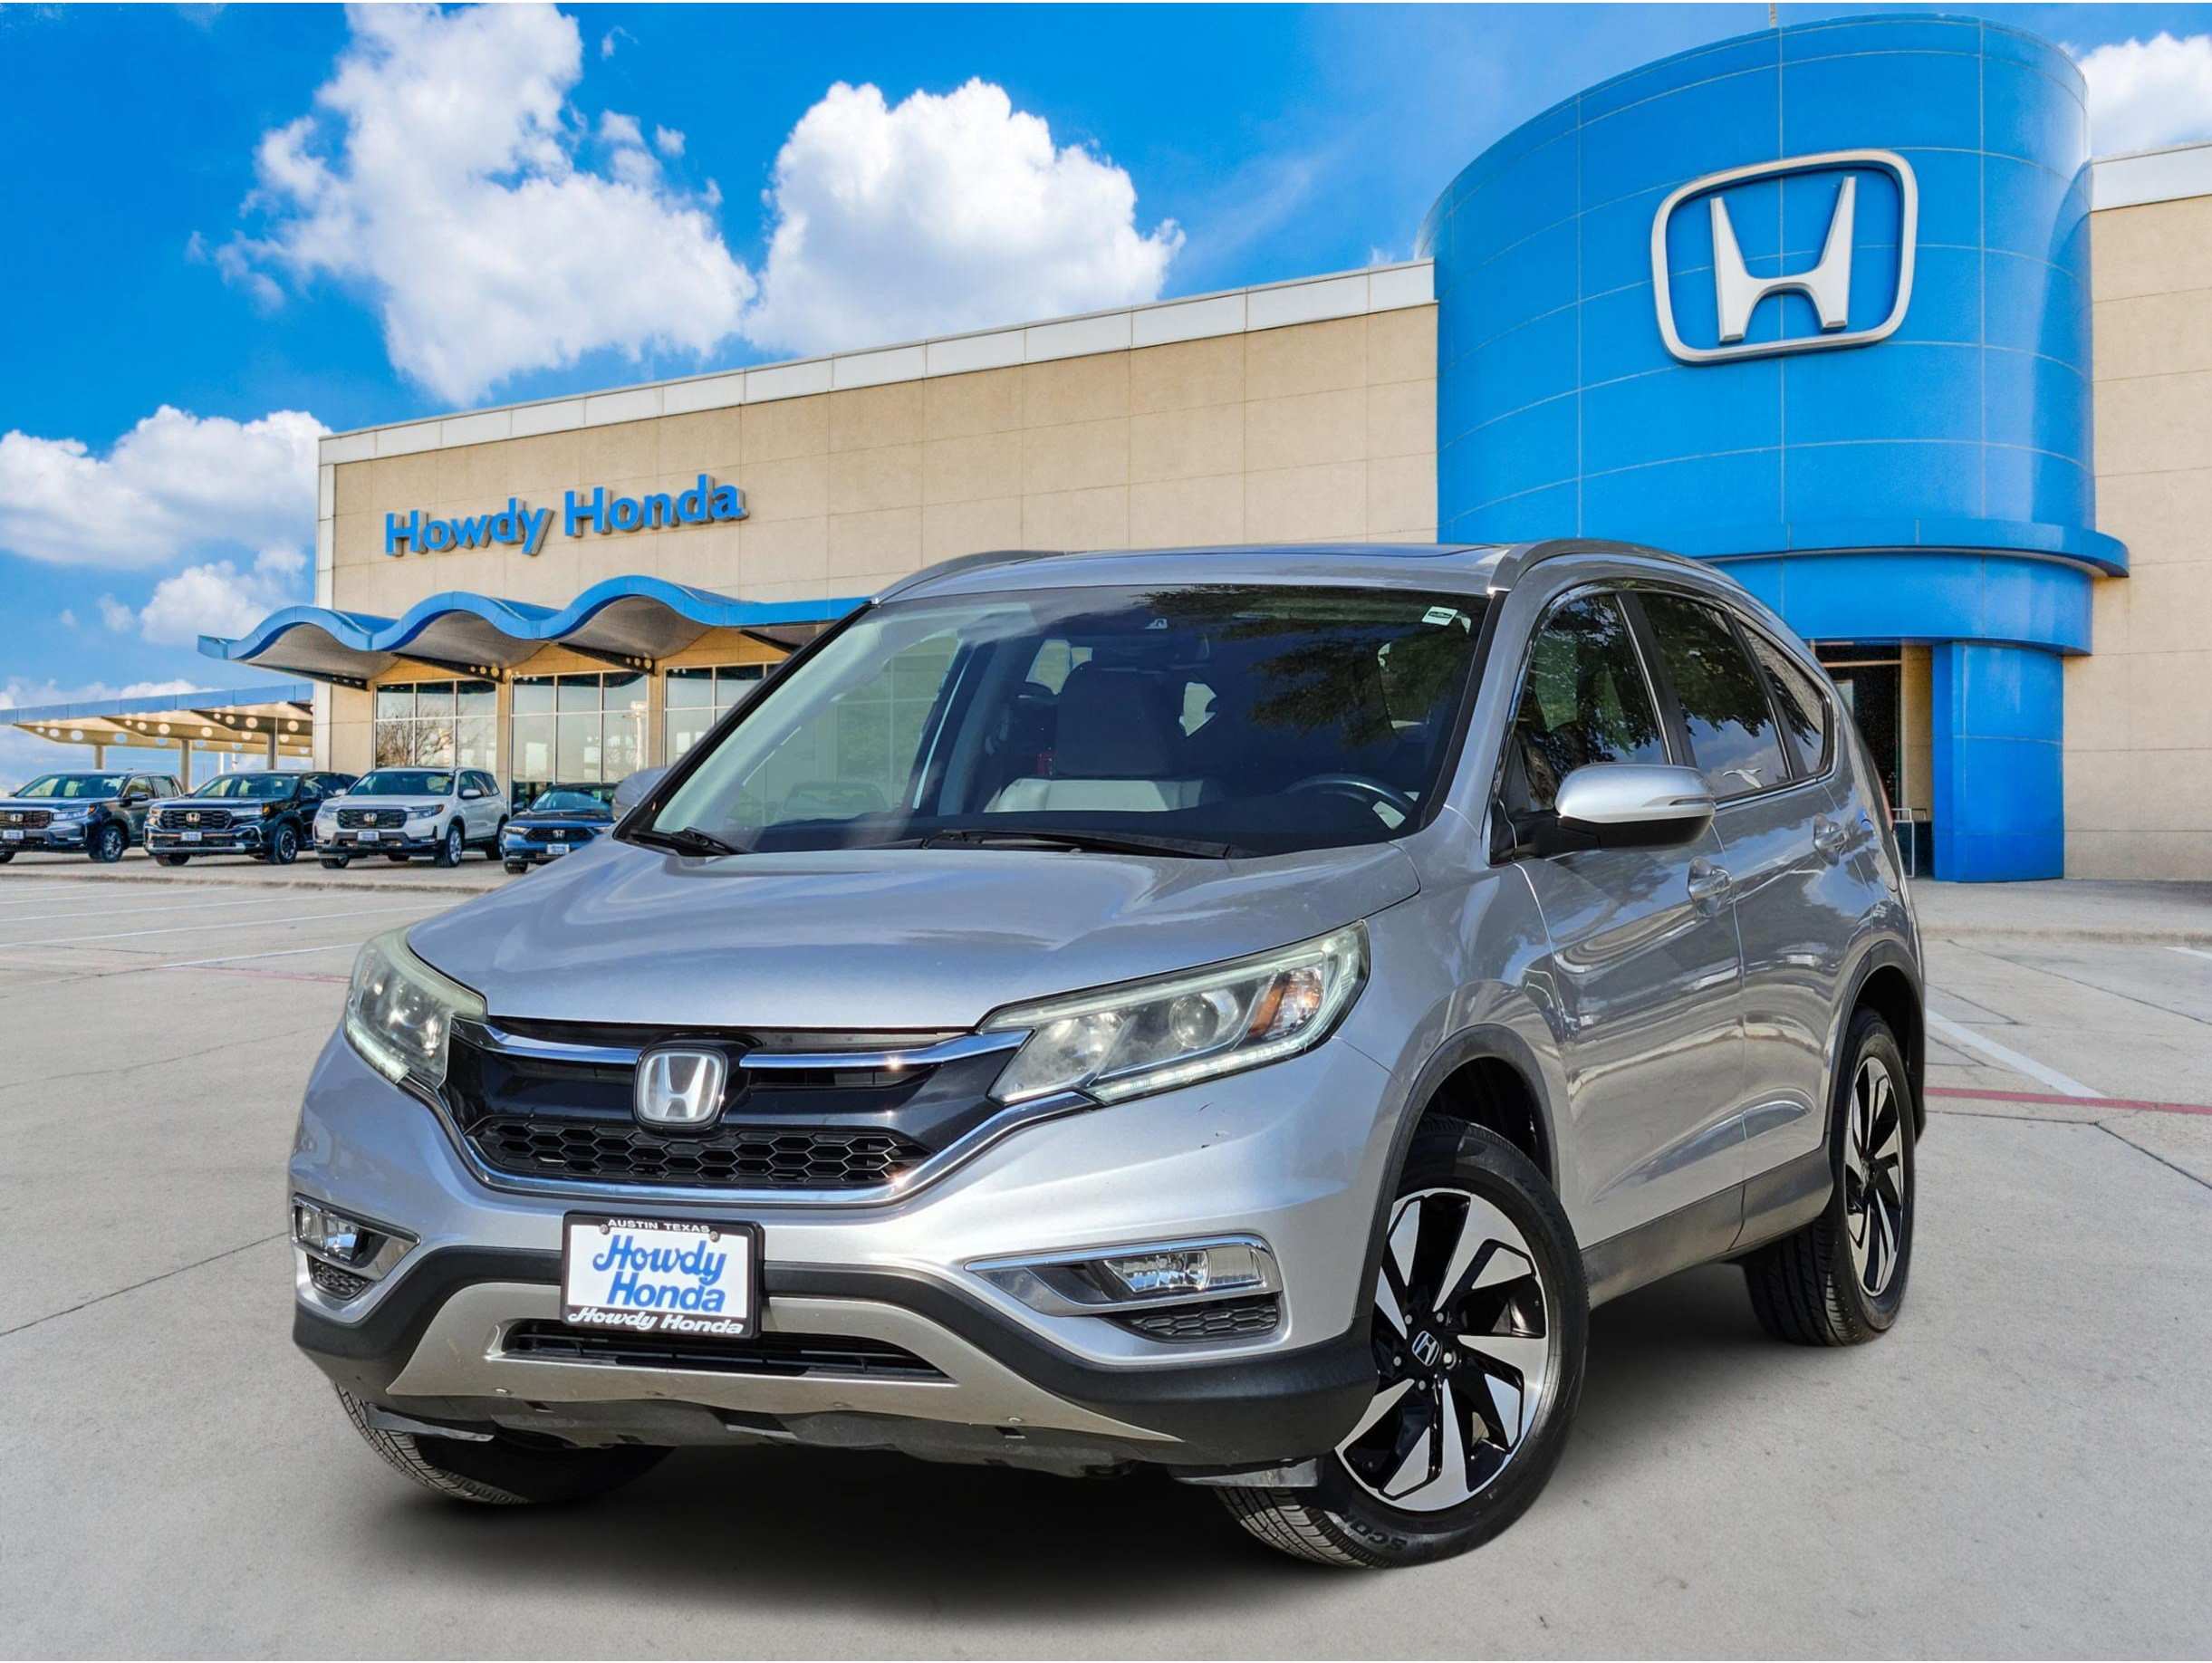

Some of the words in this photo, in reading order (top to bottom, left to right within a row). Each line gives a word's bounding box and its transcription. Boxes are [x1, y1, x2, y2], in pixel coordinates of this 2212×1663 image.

[385, 497, 554, 556] Howdy
[564, 474, 749, 538] Honda
[608, 1219, 659, 1230] AUSTIN
[664, 1223, 710, 1233] TEXAS
[592, 1235, 727, 1285] Howdy
[606, 1271, 726, 1312] Honda
[568, 1307, 658, 1331] Howdy
[660, 1313, 744, 1335] Honda
